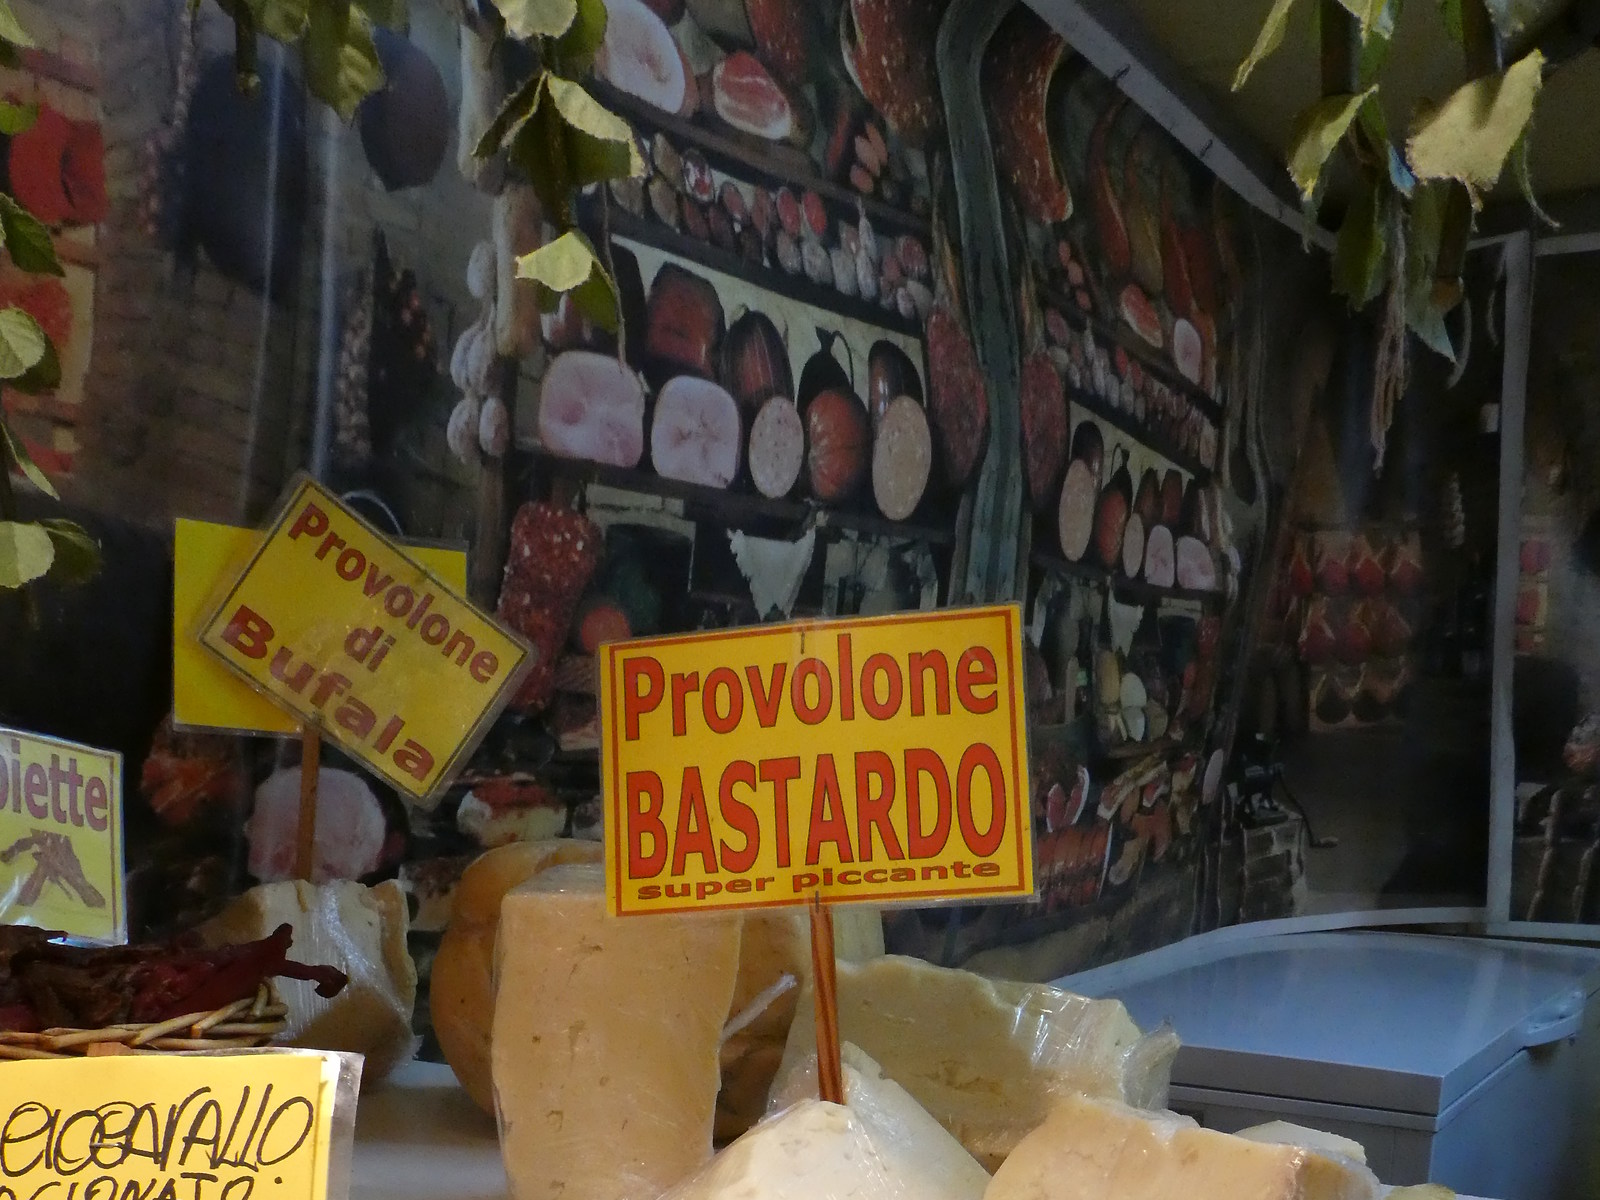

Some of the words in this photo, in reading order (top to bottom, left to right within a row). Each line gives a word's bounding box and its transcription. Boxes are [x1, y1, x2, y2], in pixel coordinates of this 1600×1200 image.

[288, 502, 499, 684] Provolone
[344, 626, 397, 673] di
[220, 604, 435, 783] Bufala
[623, 633, 999, 741] Provolone
[626, 742, 1007, 880] BASTARDO
[637, 876, 775, 900] super
[792, 861, 1001, 893] piccante
